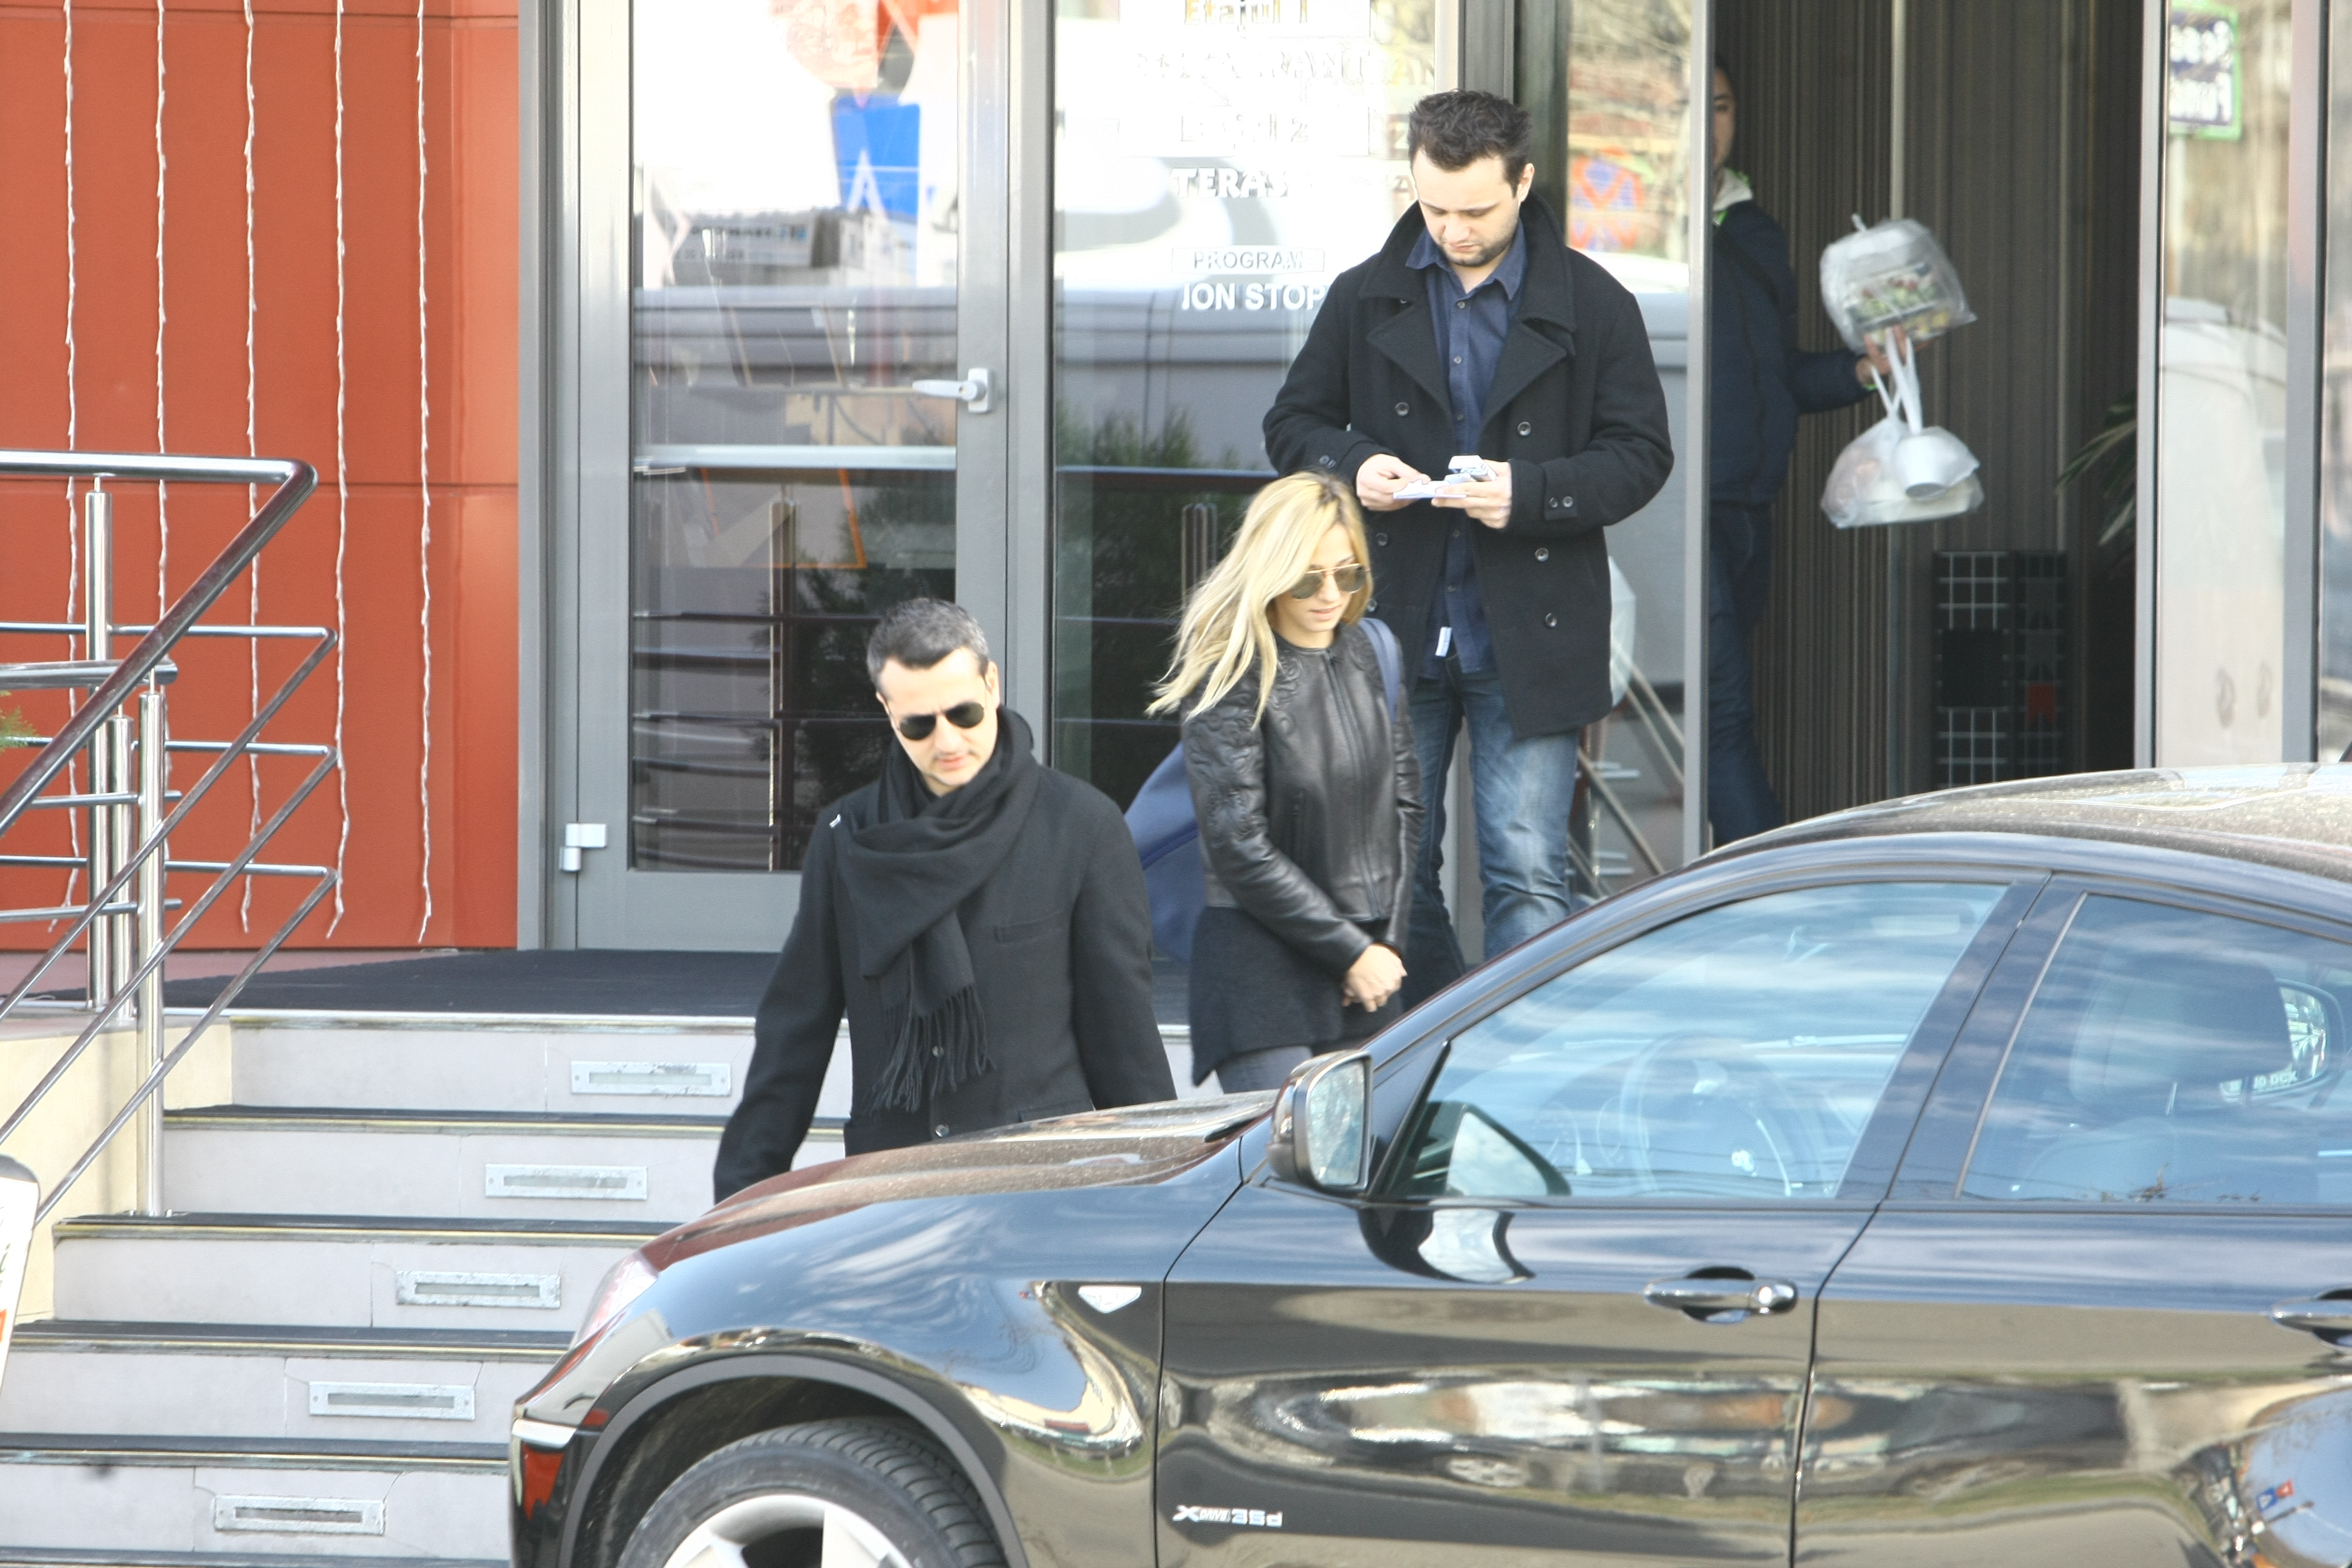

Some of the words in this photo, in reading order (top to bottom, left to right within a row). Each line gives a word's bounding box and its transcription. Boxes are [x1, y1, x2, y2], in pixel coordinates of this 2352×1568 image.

[1171, 167, 1313, 198] TERAS
[1194, 250, 1304, 270] PROGRAM
[1244, 283, 1326, 310] STOP
